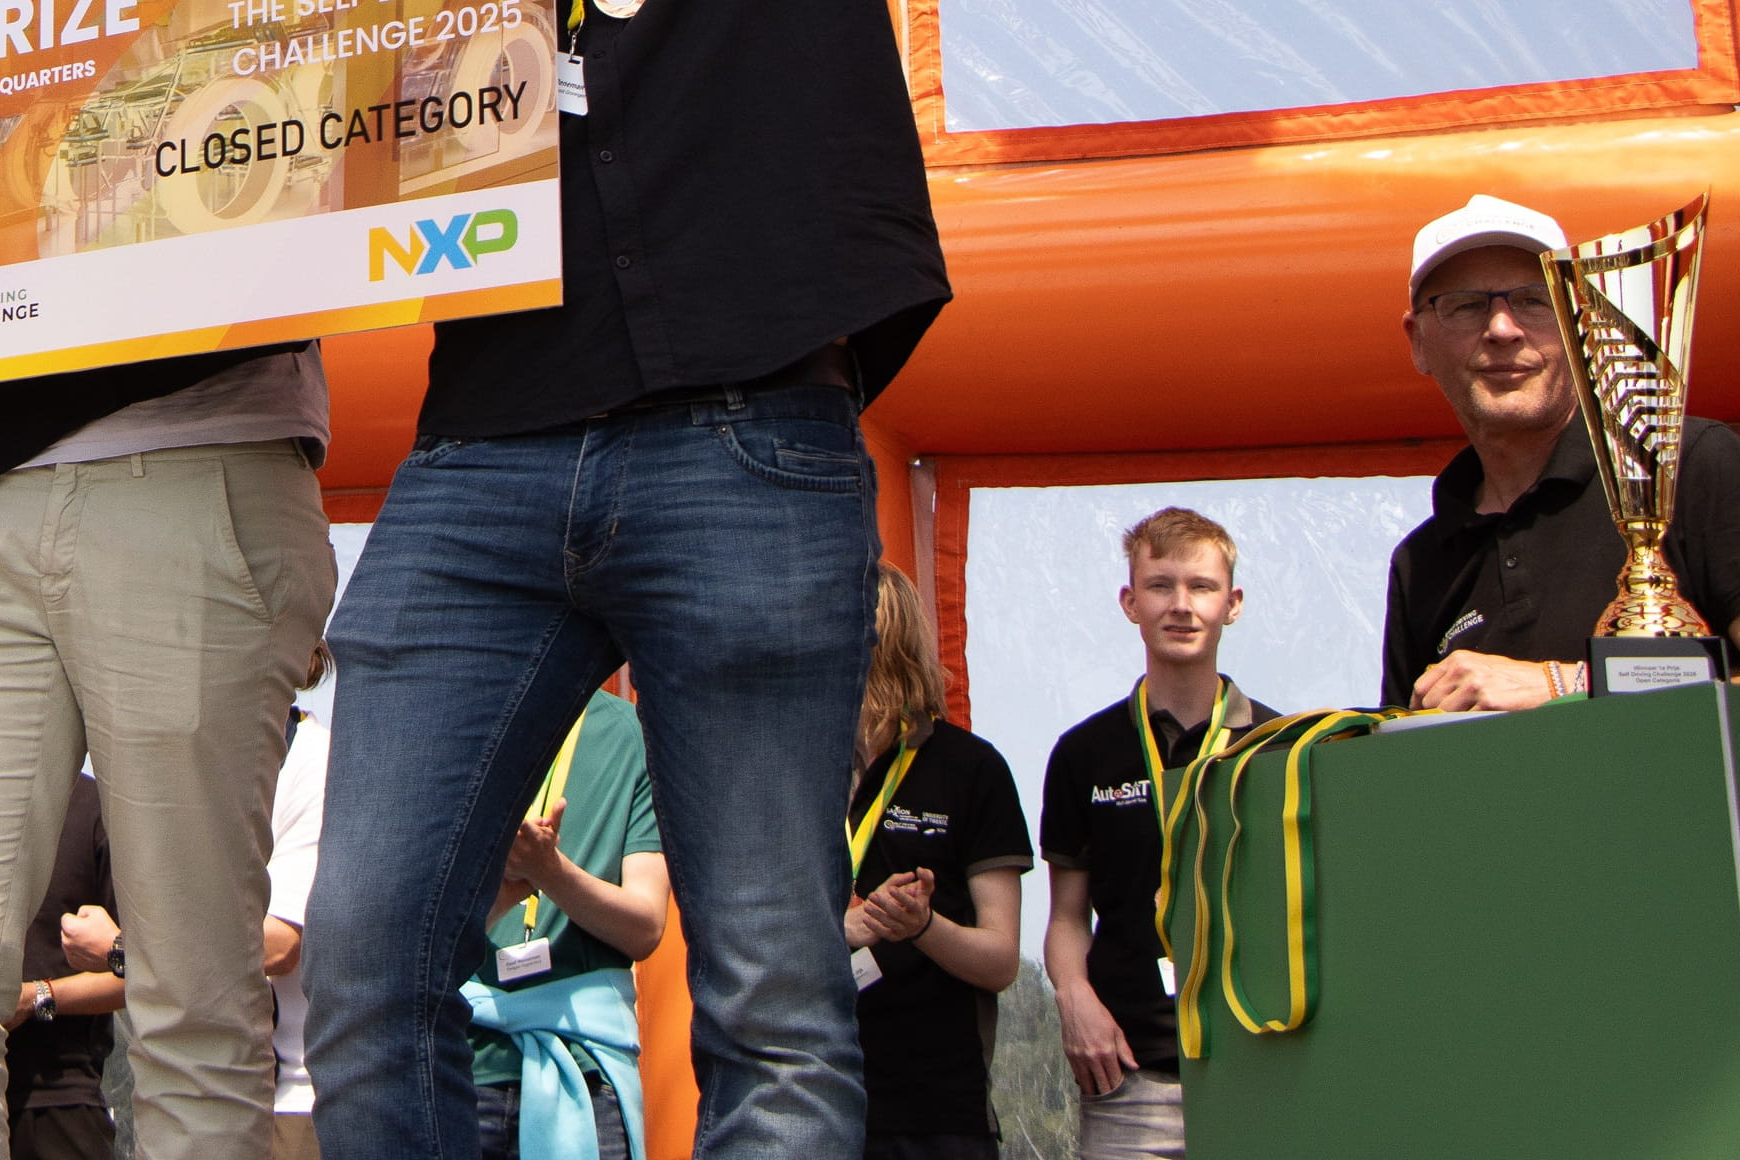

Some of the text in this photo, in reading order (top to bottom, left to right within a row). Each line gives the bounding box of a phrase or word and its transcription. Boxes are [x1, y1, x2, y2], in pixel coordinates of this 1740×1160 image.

[233, 18, 425, 76] CHALLENGE
[156, 80, 529, 177] CLOSED CATEGORY
[368, 208, 519, 282] NXP
